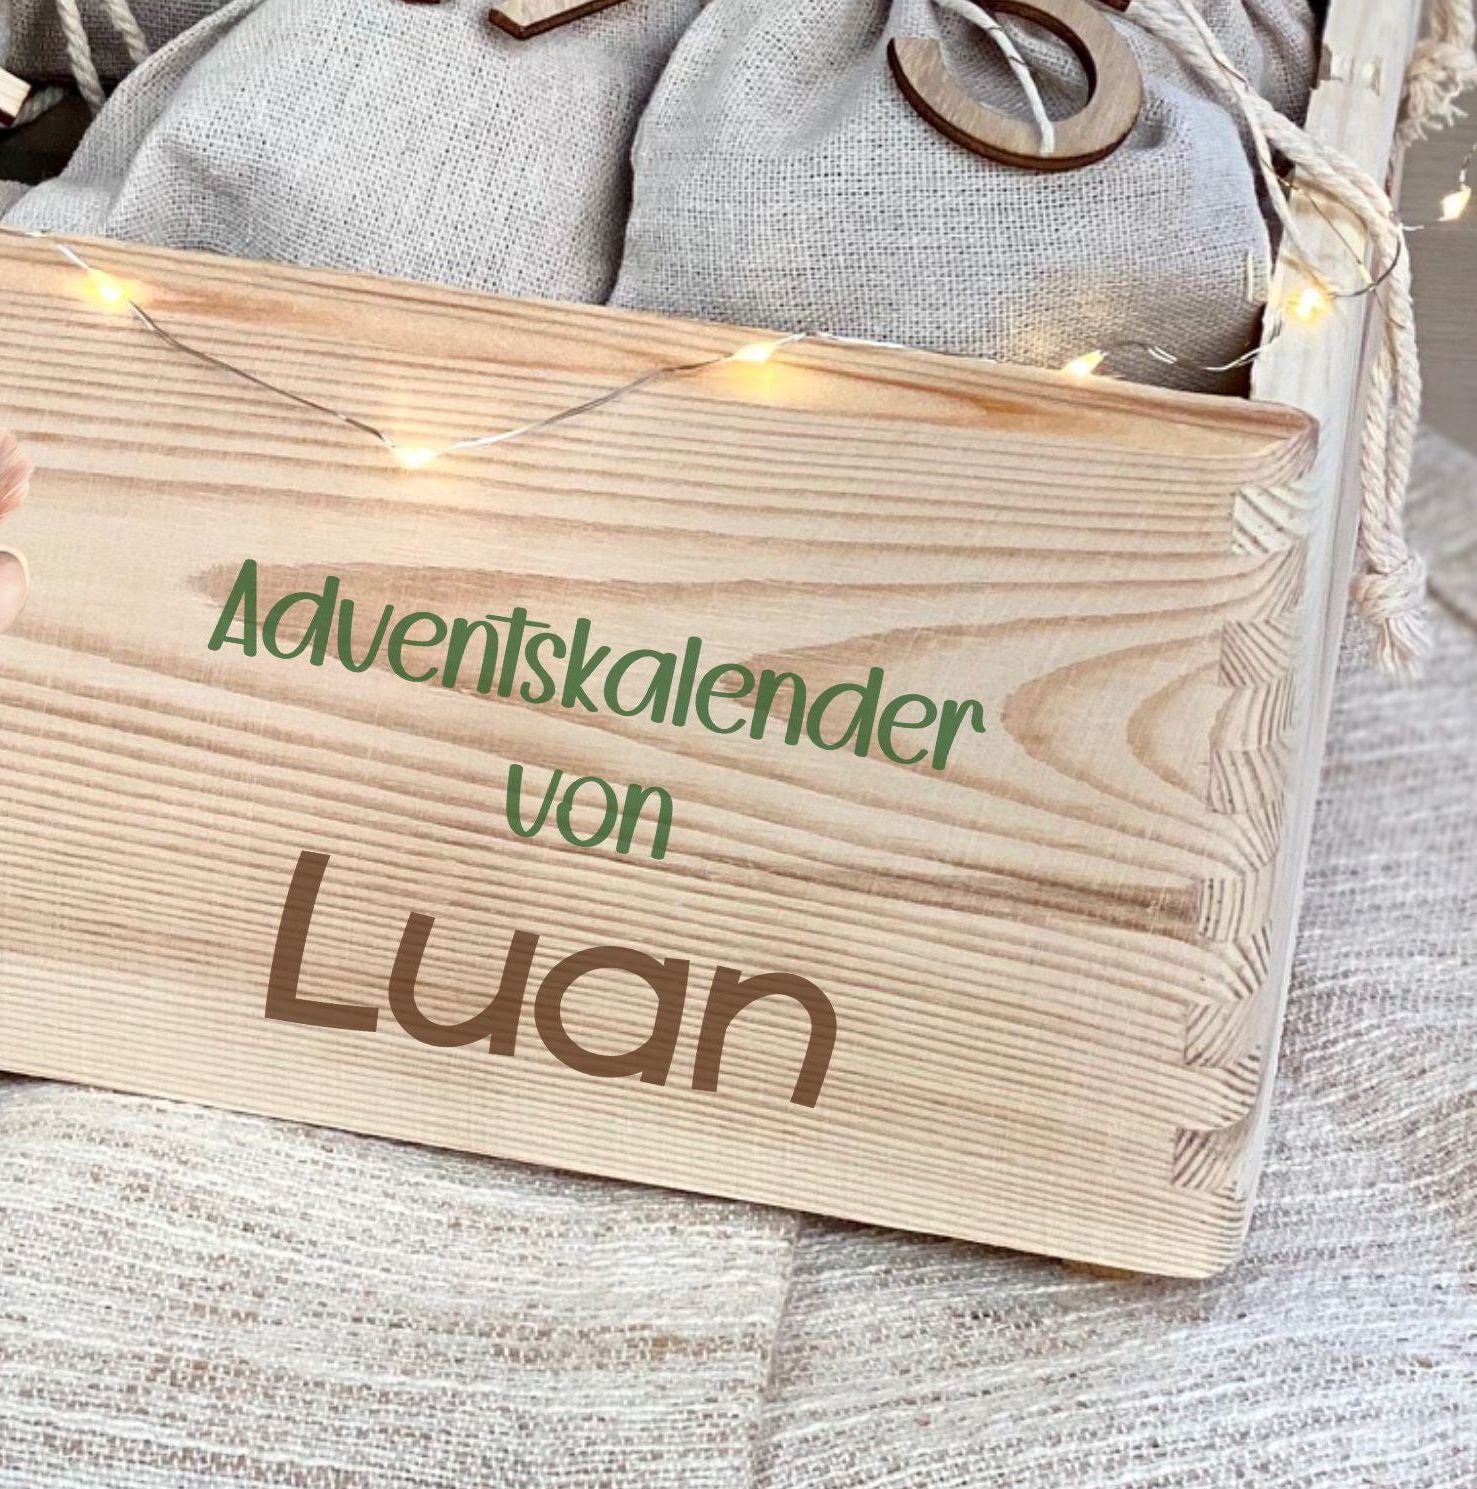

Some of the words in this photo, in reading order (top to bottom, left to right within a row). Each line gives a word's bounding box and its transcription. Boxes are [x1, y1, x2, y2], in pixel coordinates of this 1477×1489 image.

[207, 558, 986, 771] Adventskalender
[505, 763, 674, 860] von
[264, 849, 838, 1109] Luan
